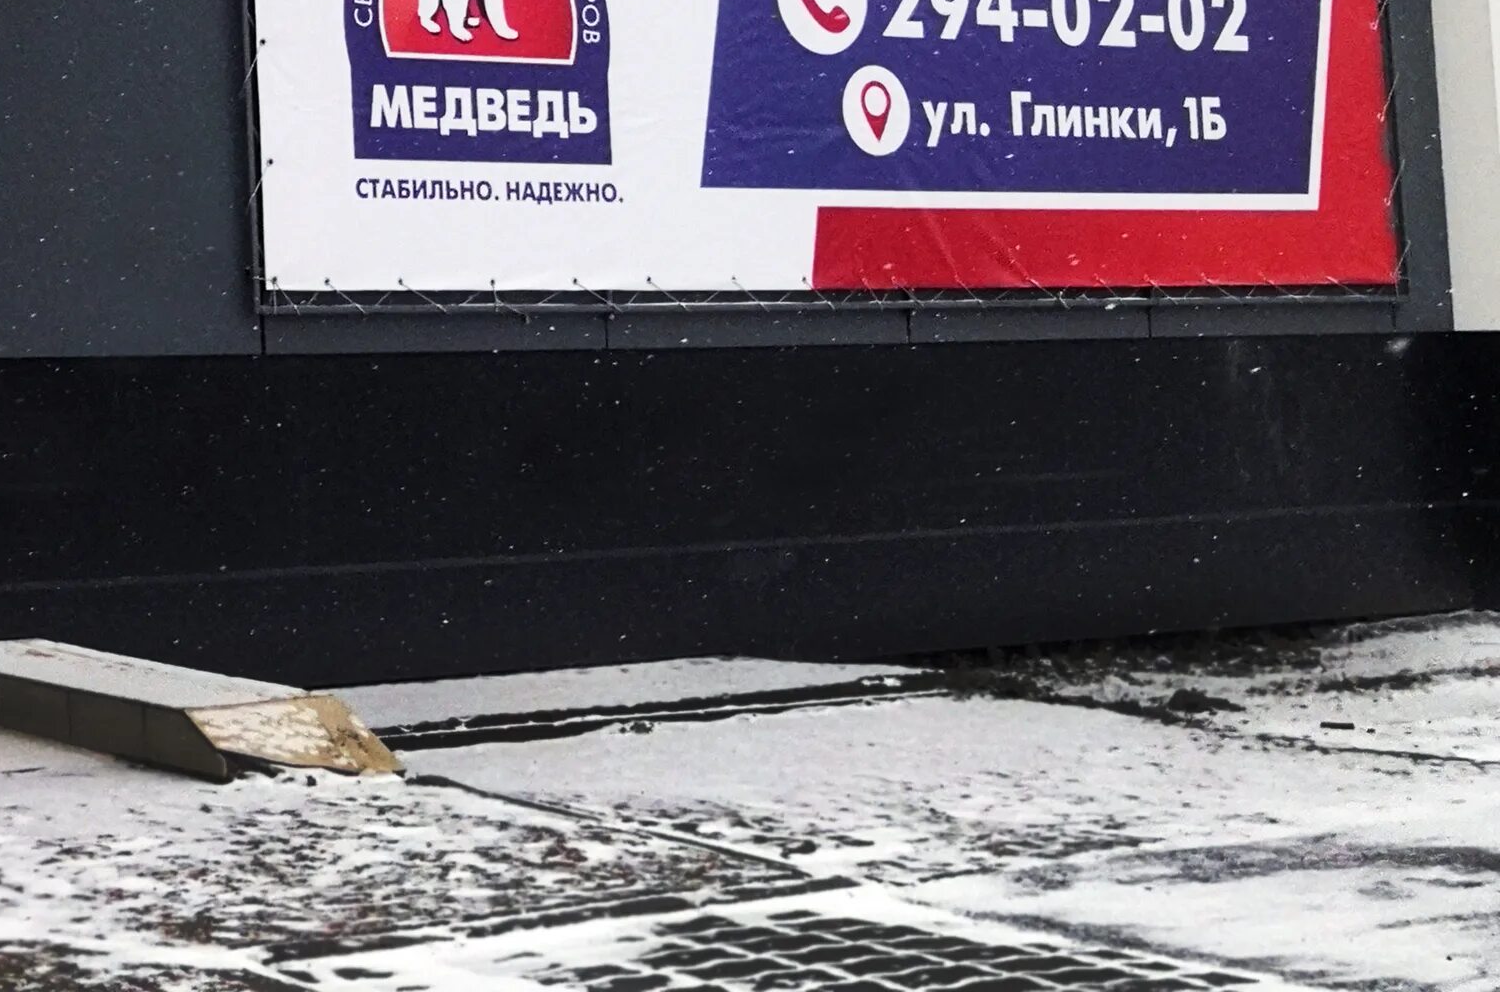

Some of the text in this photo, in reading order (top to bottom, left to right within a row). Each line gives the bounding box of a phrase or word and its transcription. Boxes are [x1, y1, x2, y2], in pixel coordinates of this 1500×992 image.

[369, 84, 598, 139] МЕДВЕДЬ
[922, 100, 991, 148] ул.
[355, 177, 625, 205] СТАБИЛЬНО. НАДЕЖНО.
